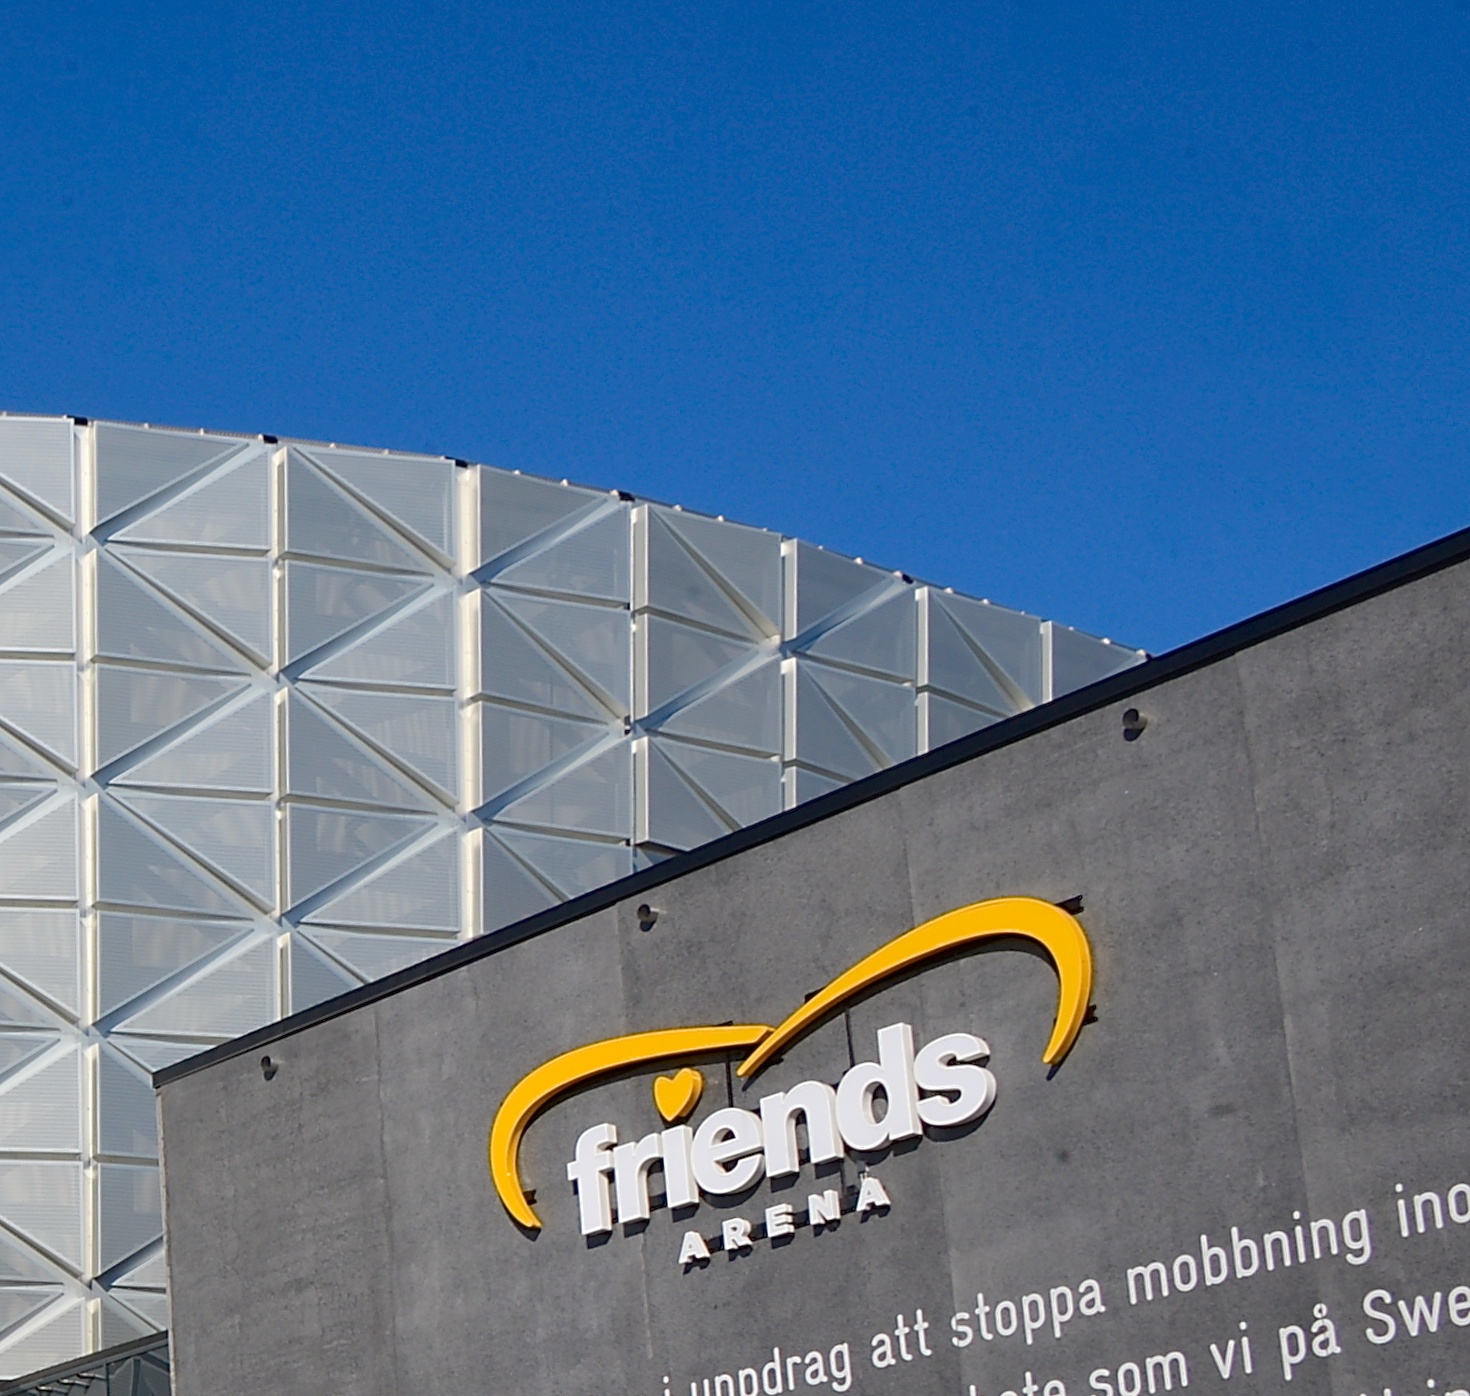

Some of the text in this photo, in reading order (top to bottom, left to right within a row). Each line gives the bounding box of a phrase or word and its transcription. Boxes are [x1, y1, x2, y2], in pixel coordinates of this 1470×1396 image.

[567, 1022, 997, 1236] friends
[678, 1174, 891, 1264] ARENA
[871, 1308, 932, 1368] att
[950, 1278, 1106, 1348] stoppa
[1126, 1208, 1371, 1305] mobbning
[1209, 1321, 1253, 1379] vi
[1278, 1303, 1342, 1381] på
